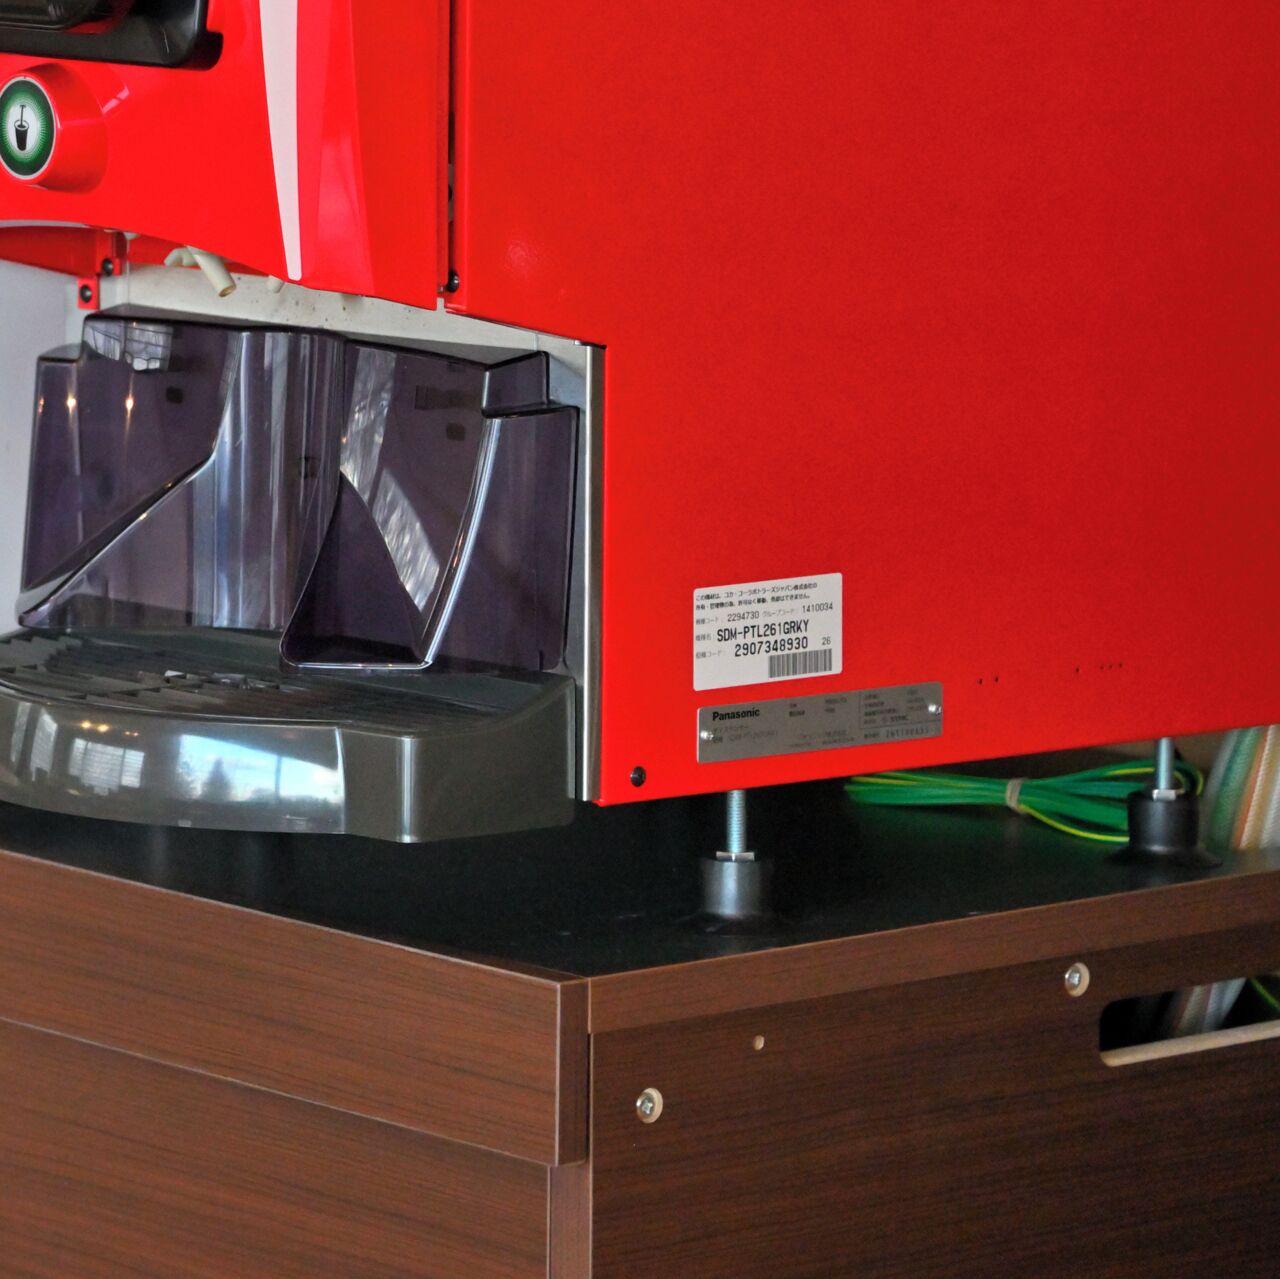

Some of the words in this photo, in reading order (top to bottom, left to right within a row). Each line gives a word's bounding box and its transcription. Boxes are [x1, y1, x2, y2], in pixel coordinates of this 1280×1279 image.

[727, 611, 760, 622] 2294730
[802, 602, 833, 614] 1410034
[717, 620, 809, 642] SDM-PTL261GRKY
[734, 636, 808, 657] 2907348930
[821, 636, 832, 646] 26
[712, 707, 760, 721] Panasonic
